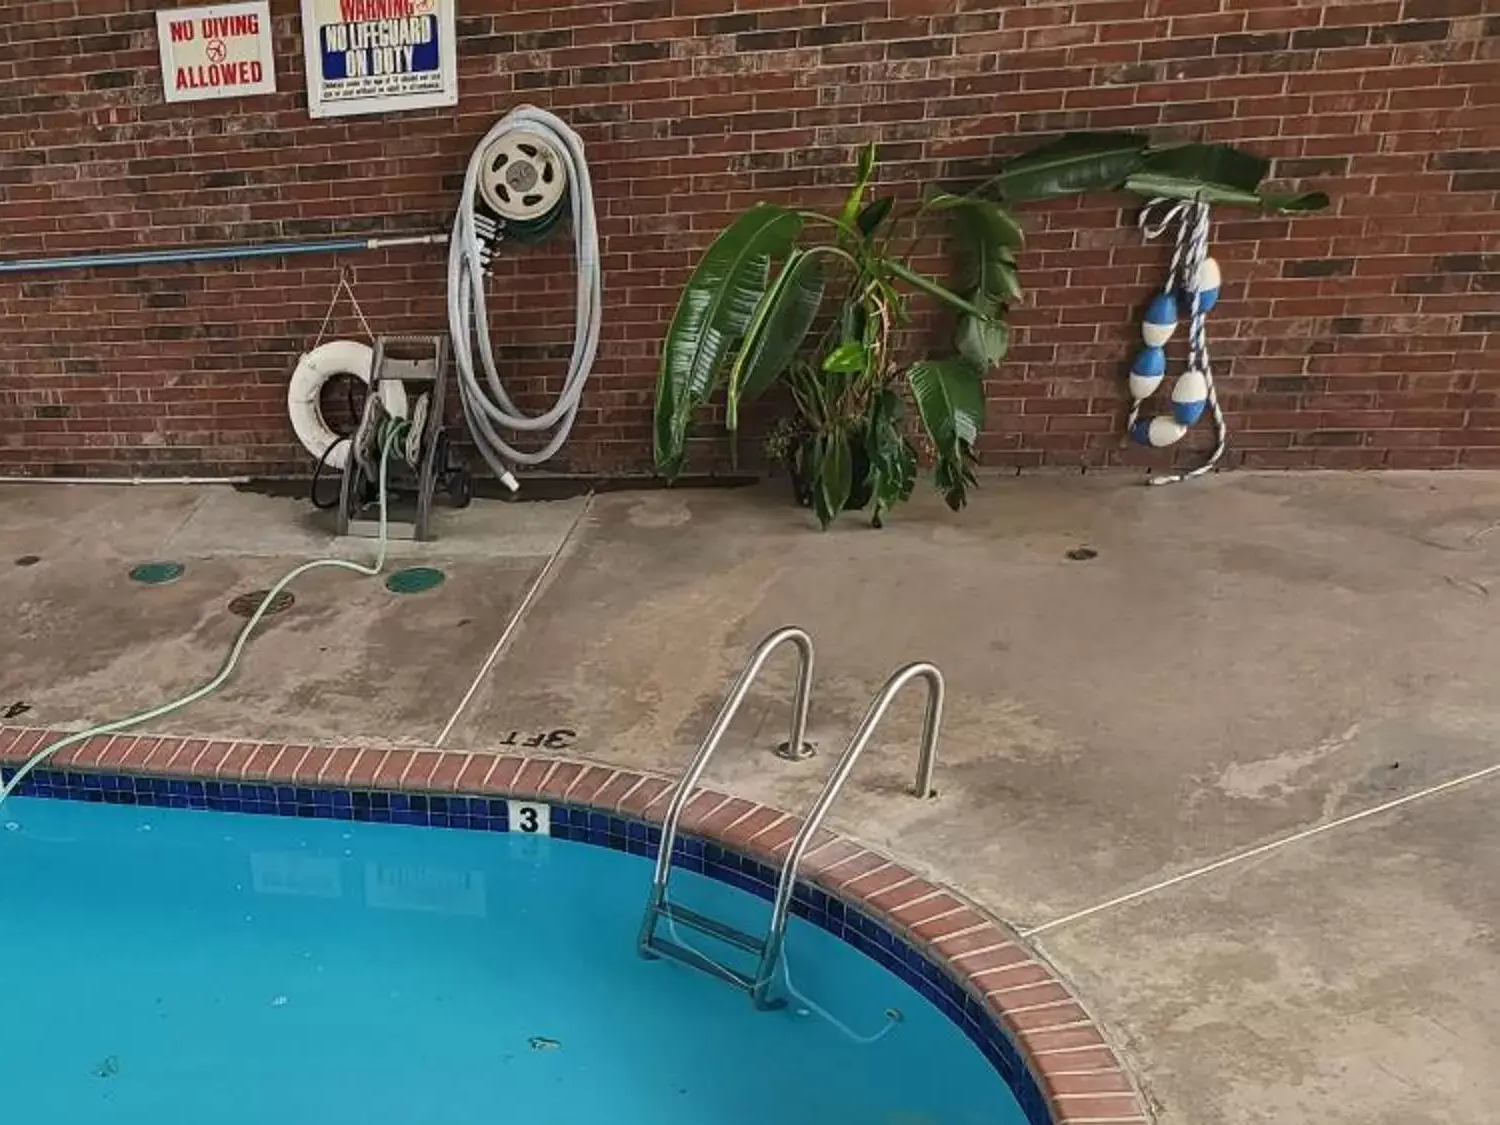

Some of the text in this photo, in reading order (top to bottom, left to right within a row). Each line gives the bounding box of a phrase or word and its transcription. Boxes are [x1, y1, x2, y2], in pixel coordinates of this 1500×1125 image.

[170, 14, 259, 42] NO DIVING
[325, 15, 432, 53] NO LIFEGUARD
[176, 61, 262, 90] ALLOWED
[345, 46, 414, 77] ON DUTY
[500, 729, 576, 750] 3FT
[520, 807, 538, 833] 3
